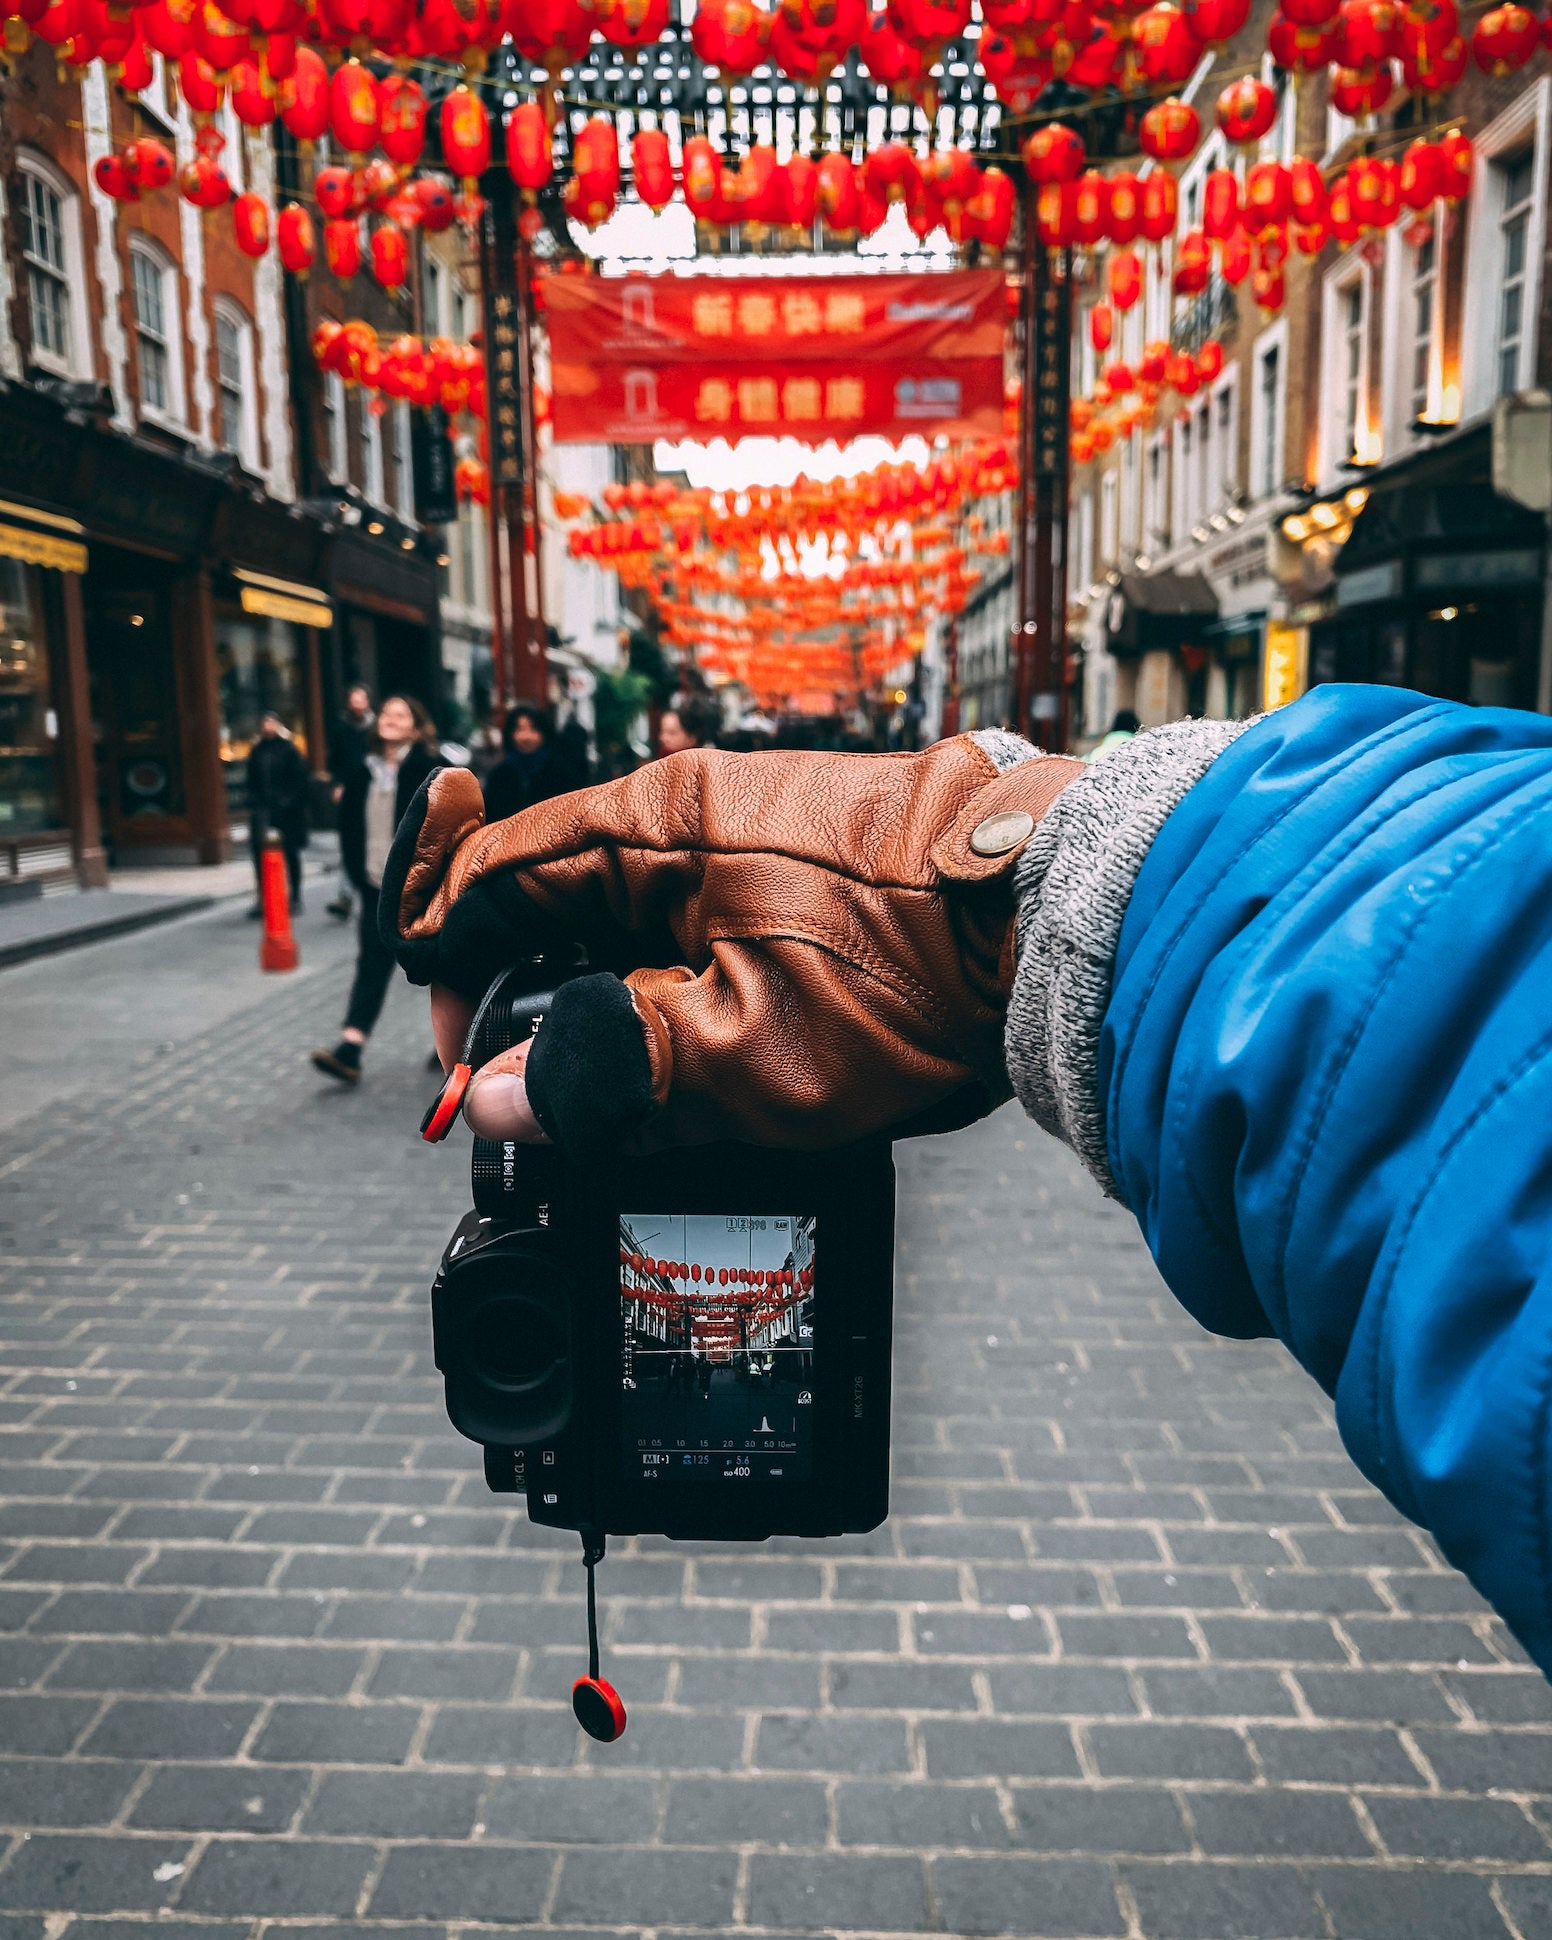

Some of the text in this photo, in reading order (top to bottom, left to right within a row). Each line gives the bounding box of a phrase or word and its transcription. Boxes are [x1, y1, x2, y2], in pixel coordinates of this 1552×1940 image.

[539, 1203, 548, 1226] AE-L
[854, 1376, 864, 1418] MK-XT2G
[723, 1440, 734, 1448] 2.0
[745, 1440, 756, 1448] 3.0
[693, 1455, 710, 1465] 125
[736, 1456, 750, 1465] 5.6
